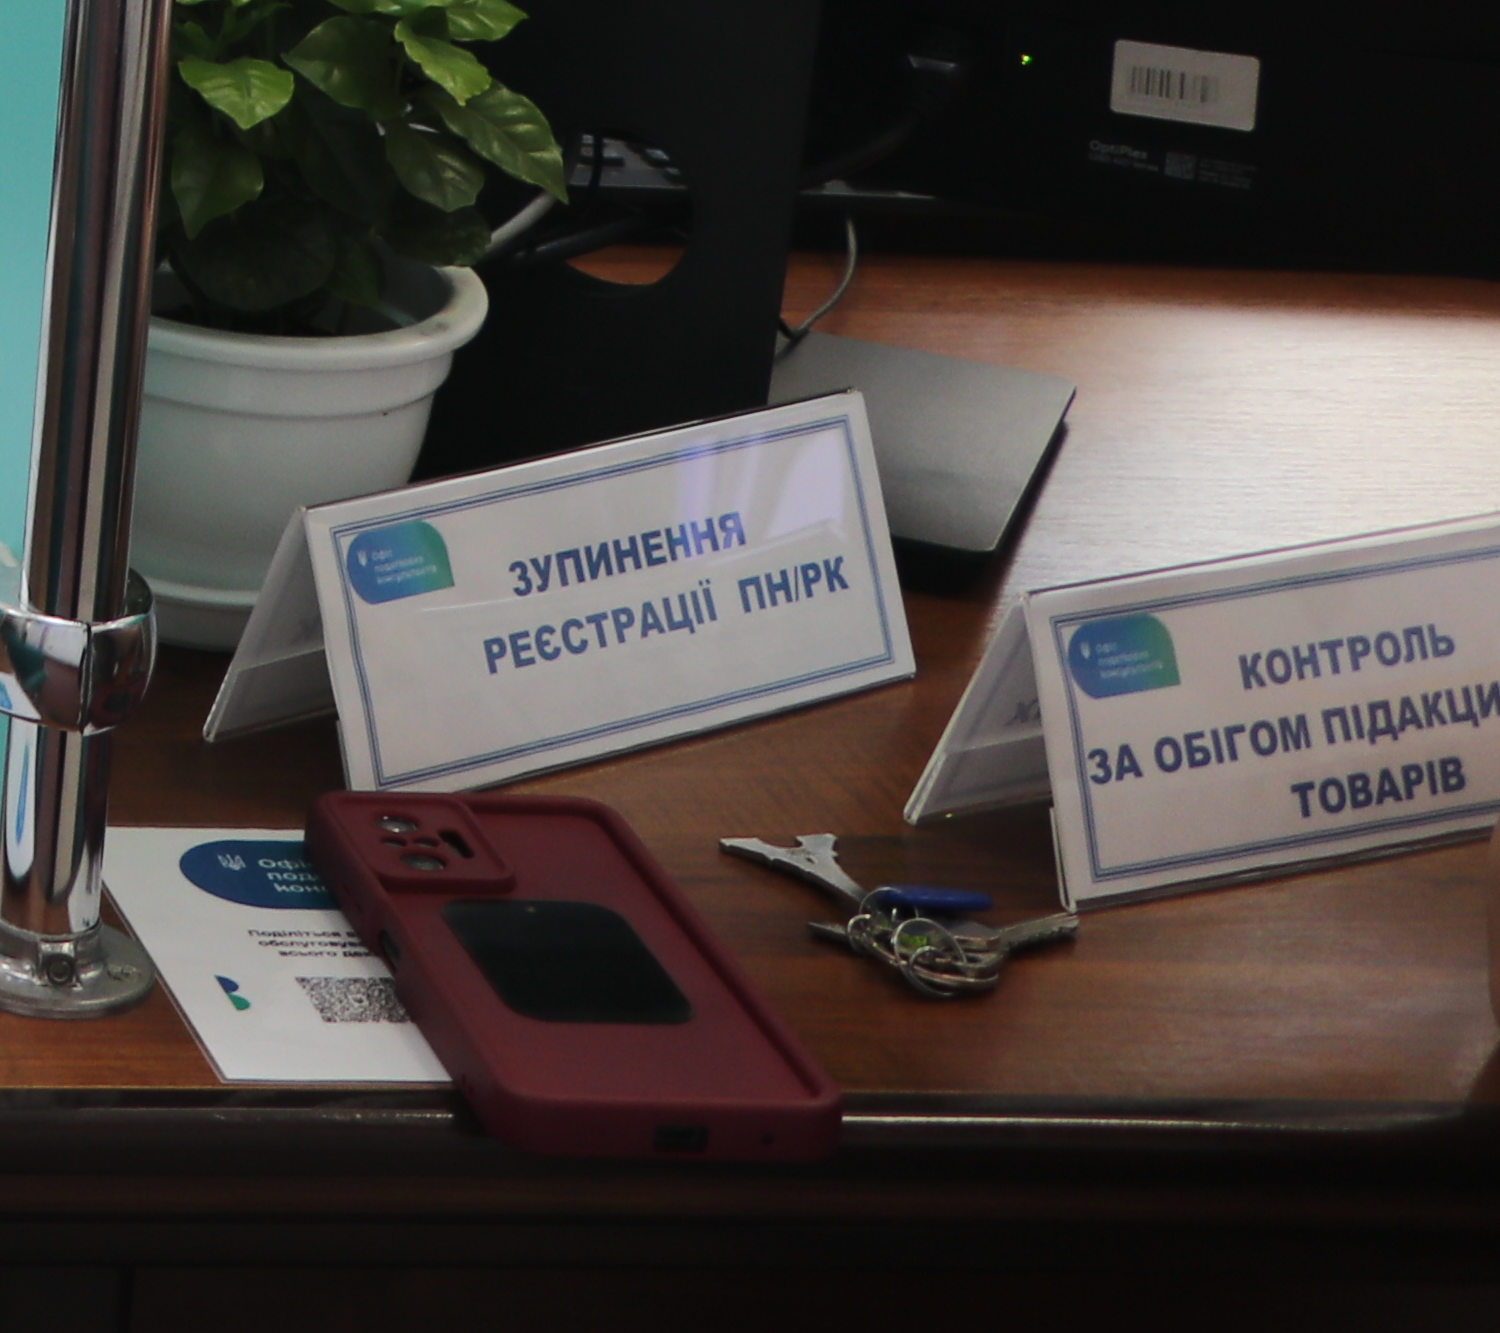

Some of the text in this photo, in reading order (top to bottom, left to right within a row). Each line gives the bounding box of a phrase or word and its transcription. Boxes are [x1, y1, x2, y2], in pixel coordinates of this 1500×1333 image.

[1089, 139, 1148, 159] OptiPlex
[508, 510, 747, 597] ЗУПИНЕННЯ
[483, 555, 850, 674] РЕЄСТРАЦІЇ ПН/РК
[1238, 622, 1456, 689] КОНТРОЛЬ
[1087, 745, 1143, 785] ЗА
[1154, 713, 1311, 772] ОБІГОМ
[1291, 757, 1467, 818] ТОВАРІВ
[258, 858, 309, 871] Офі
[248, 929, 341, 938] Поділіться
